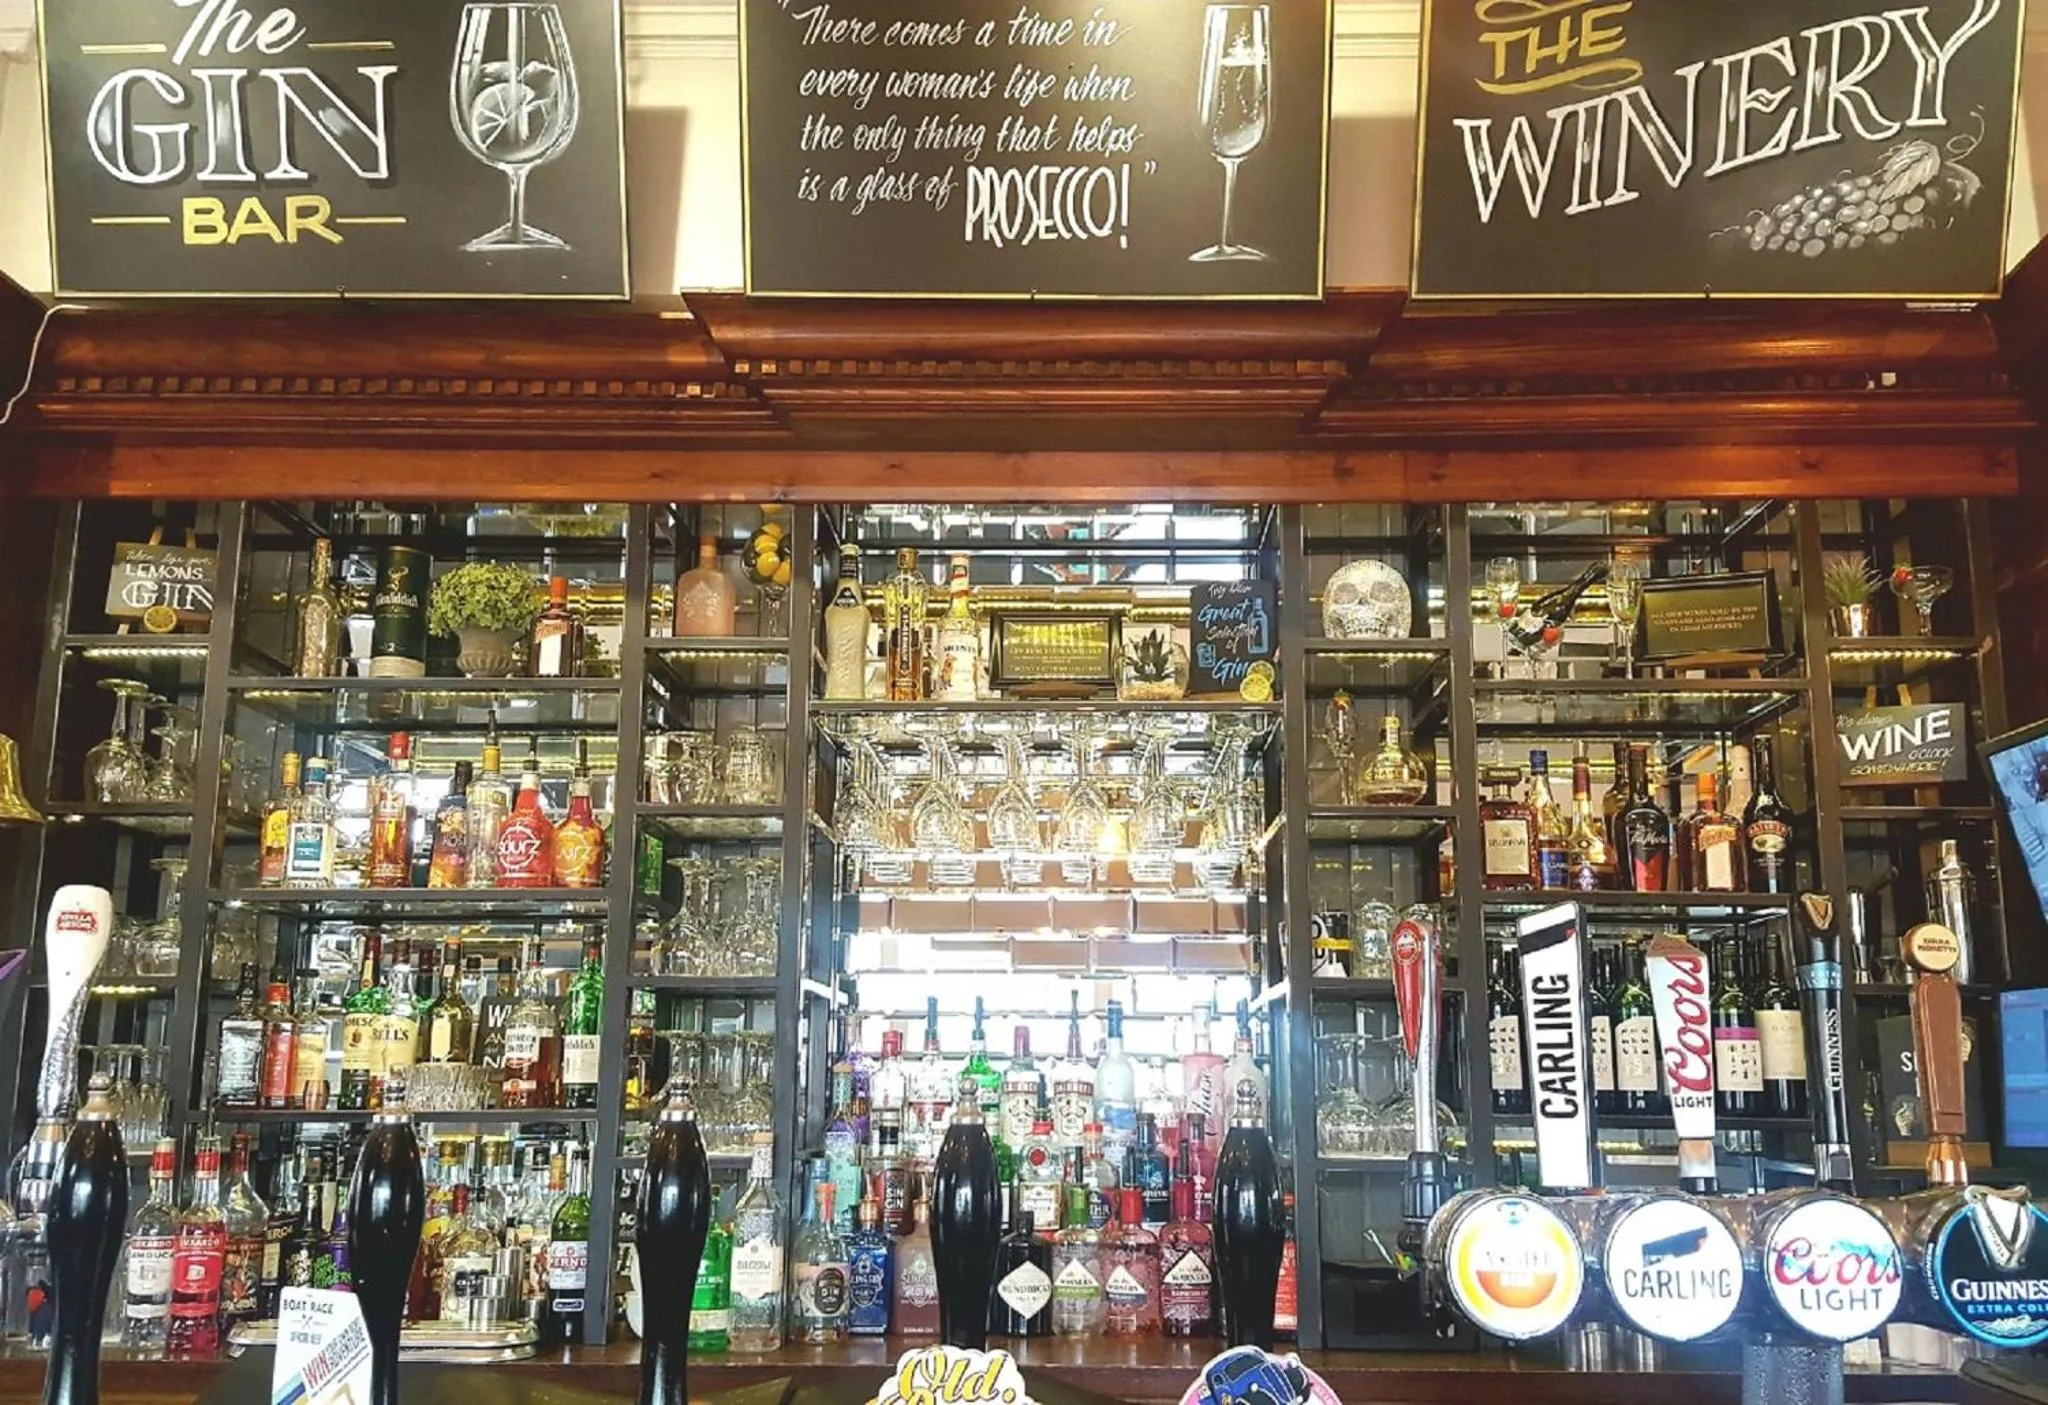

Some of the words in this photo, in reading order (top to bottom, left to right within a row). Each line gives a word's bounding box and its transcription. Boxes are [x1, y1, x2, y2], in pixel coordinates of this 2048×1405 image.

[171, 0, 307, 65] The
[884, 21, 971, 47] comes
[974, 25, 998, 47] a
[1007, 5, 1073, 48] time
[1082, 8, 1132, 47] in
[1478, 7, 1628, 80] THE
[799, 68, 878, 109] every
[885, 65, 998, 101] woman's
[1003, 63, 1056, 106] life
[1062, 65, 1137, 103] when
[86, 65, 399, 183] GIN
[1453, 0, 2003, 223] WINERY
[800, 113, 844, 152] the
[853, 119, 908, 163] only
[913, 112, 986, 163] thing
[995, 114, 1063, 156] that
[1067, 113, 1146, 156] helps
[797, 167, 825, 203] is
[830, 178, 850, 201] a
[854, 167, 922, 217] glass
[924, 166, 962, 211] of
[182, 195, 345, 245] BAR
[122, 580, 215, 611] GIN
[1197, 598, 1253, 629] Great
[1212, 657, 1249, 688] Gin
[1838, 709, 1952, 761] WINE
[372, 1026, 410, 1042] BELL'S
[1531, 973, 1579, 1120] CARLING
[1663, 955, 1713, 1095] Coors
[1825, 1008, 1843, 1092] GUINNESS
[1675, 1096, 1713, 1108] LIGHT
[283, 1299, 307, 1311] BOAT
[310, 1303, 334, 1315] RACE
[1624, 1268, 1734, 1301] CARLING
[1799, 1288, 1883, 1312] LIGHT
[1951, 1278, 2048, 1302] GUINNES
[1967, 1303, 2013, 1314] EXTRA
[2017, 1303, 2048, 1315] COL
[899, 1349, 1008, 1401] Old
